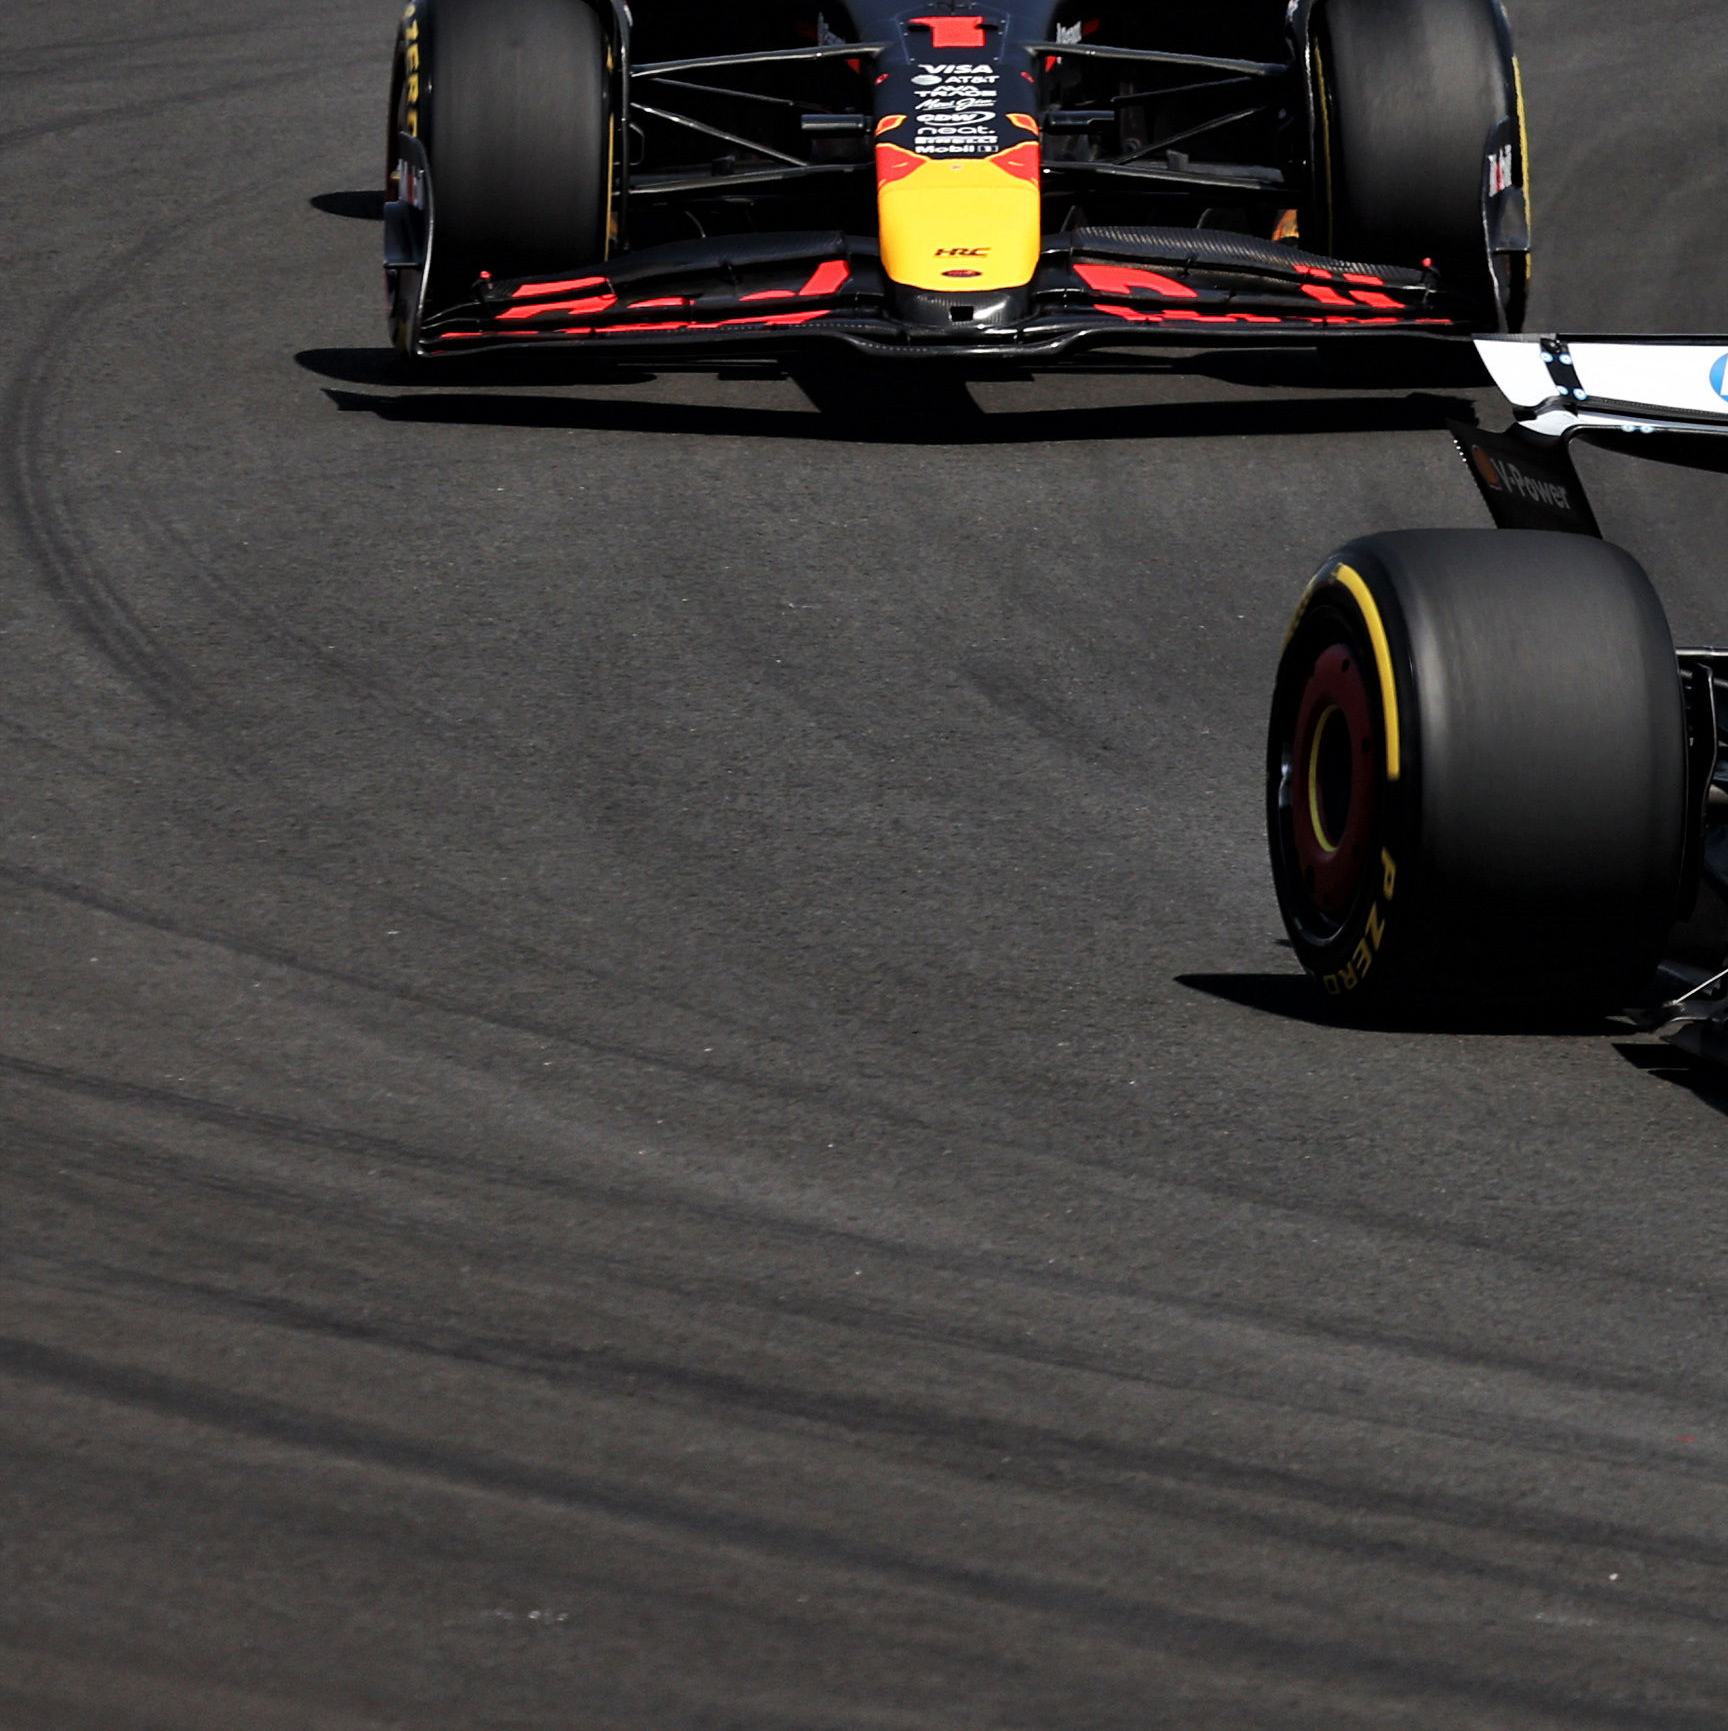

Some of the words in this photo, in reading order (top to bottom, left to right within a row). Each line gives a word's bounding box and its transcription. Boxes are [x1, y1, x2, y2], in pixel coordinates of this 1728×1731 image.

[918, 64, 993, 74] VISA
[945, 75, 999, 84] AT&T
[915, 145, 975, 154] Mobil
